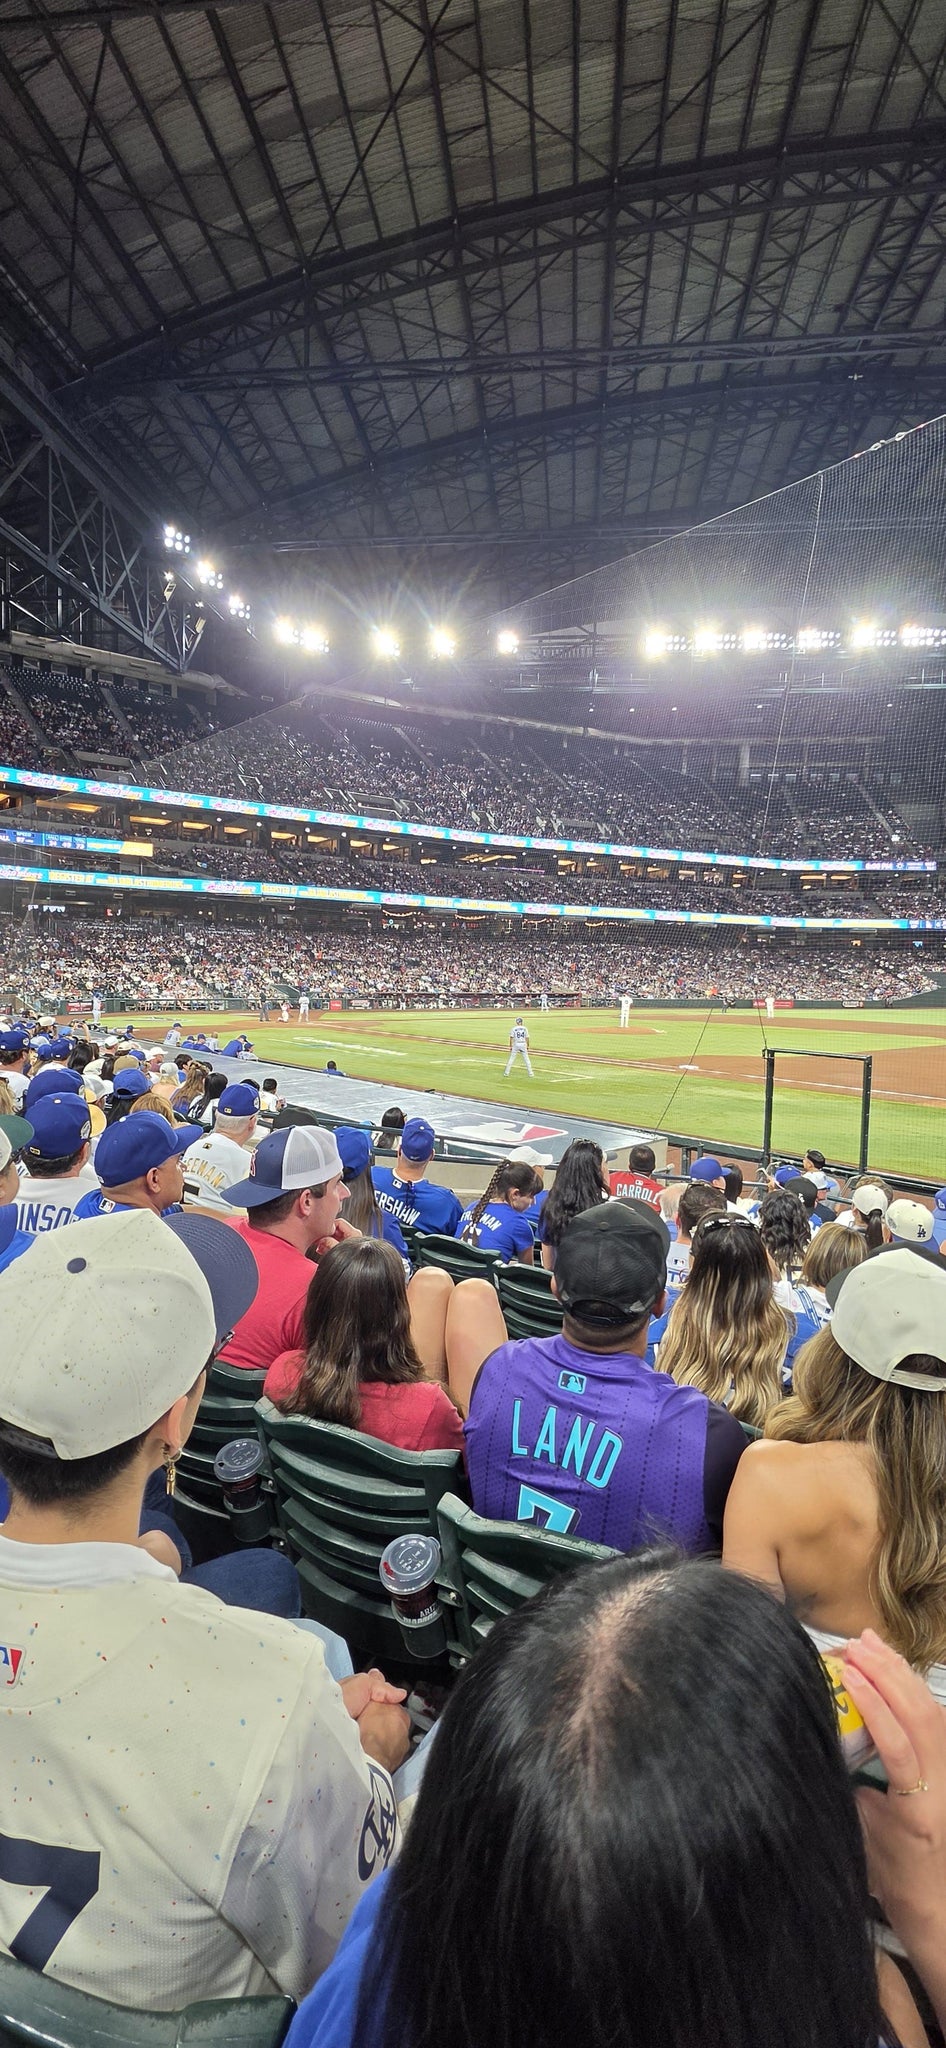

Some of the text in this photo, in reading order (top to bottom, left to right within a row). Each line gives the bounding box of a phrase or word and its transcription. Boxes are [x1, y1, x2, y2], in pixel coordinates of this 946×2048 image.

[516, 1031, 525, 1039] 84
[616, 1183, 658, 1205] CARROLL
[917, 1224, 926, 1238] LA
[511, 1398, 625, 1490] LAND
[516, 1483, 581, 1535] 7
[0, 1831, 101, 1973] 7
